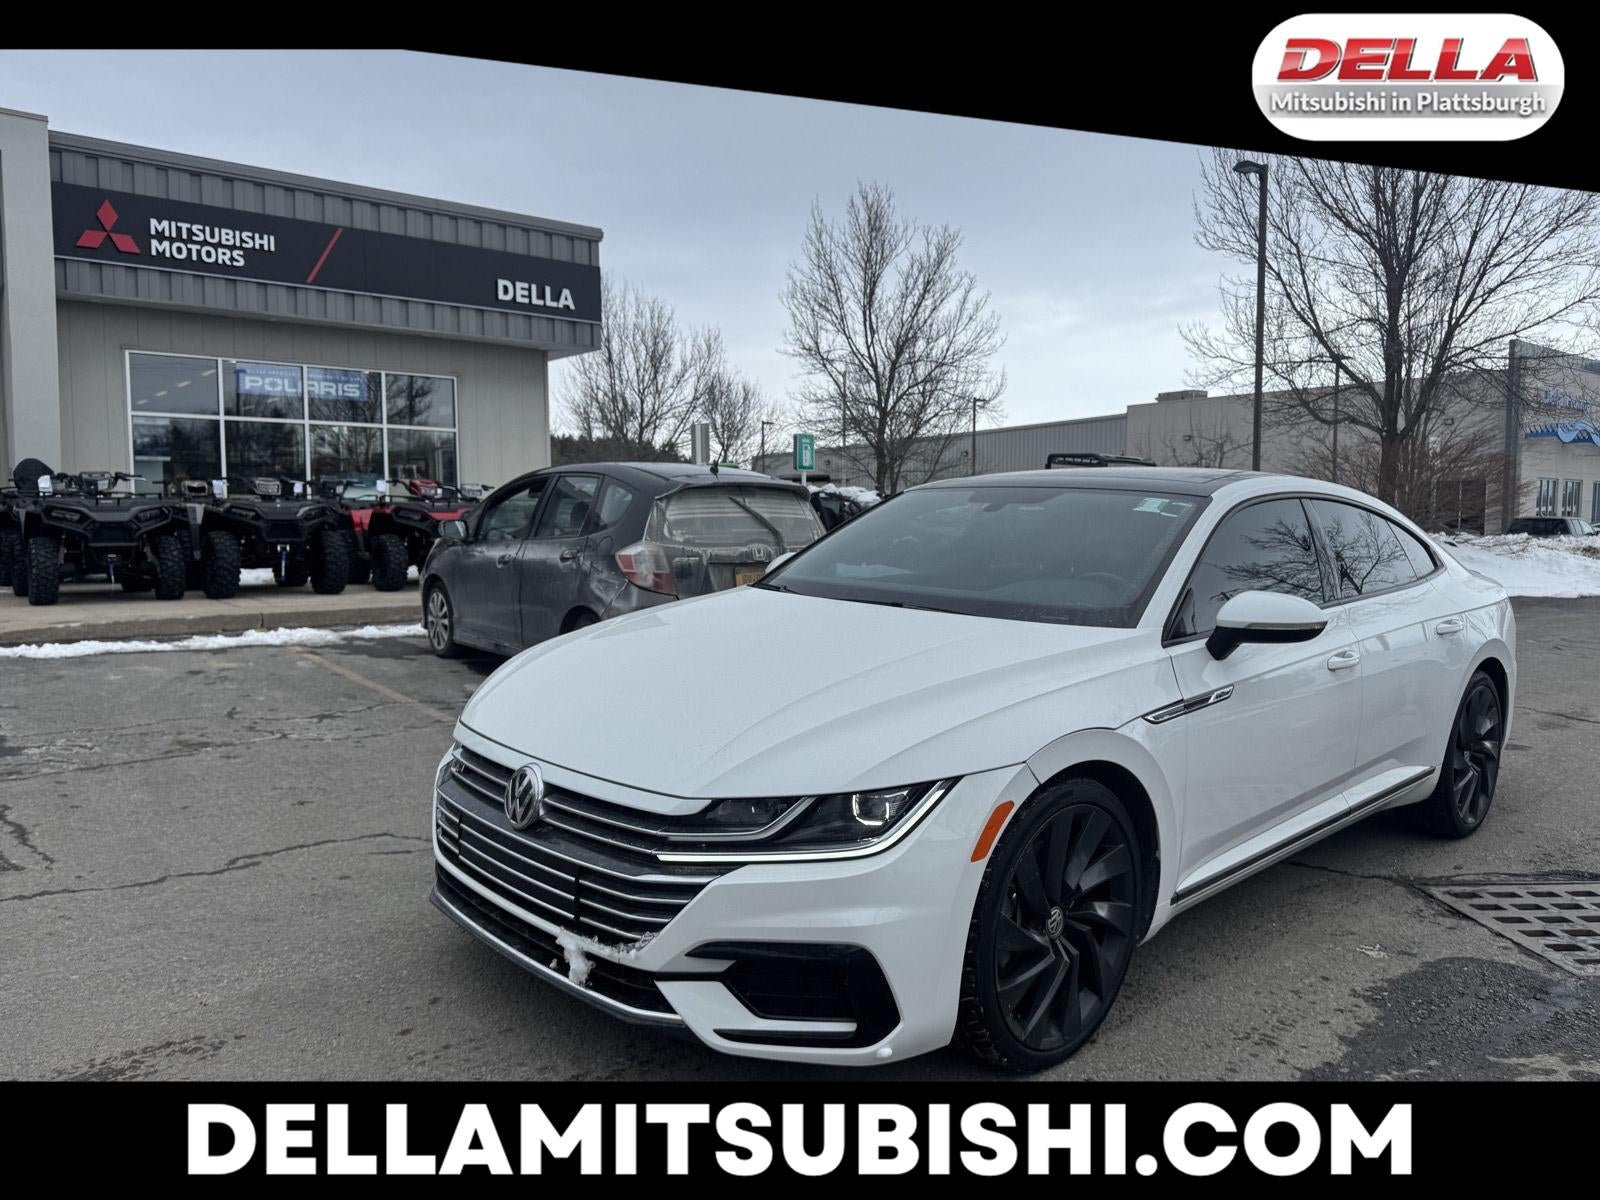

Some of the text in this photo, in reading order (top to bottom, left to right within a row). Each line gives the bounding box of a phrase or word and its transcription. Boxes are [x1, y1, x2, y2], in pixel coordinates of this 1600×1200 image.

[149, 217, 276, 252] MITSUBISHI
[150, 238, 246, 267] MOTORS
[496, 278, 576, 310] DELLA
[244, 375, 361, 398] POLARIS
